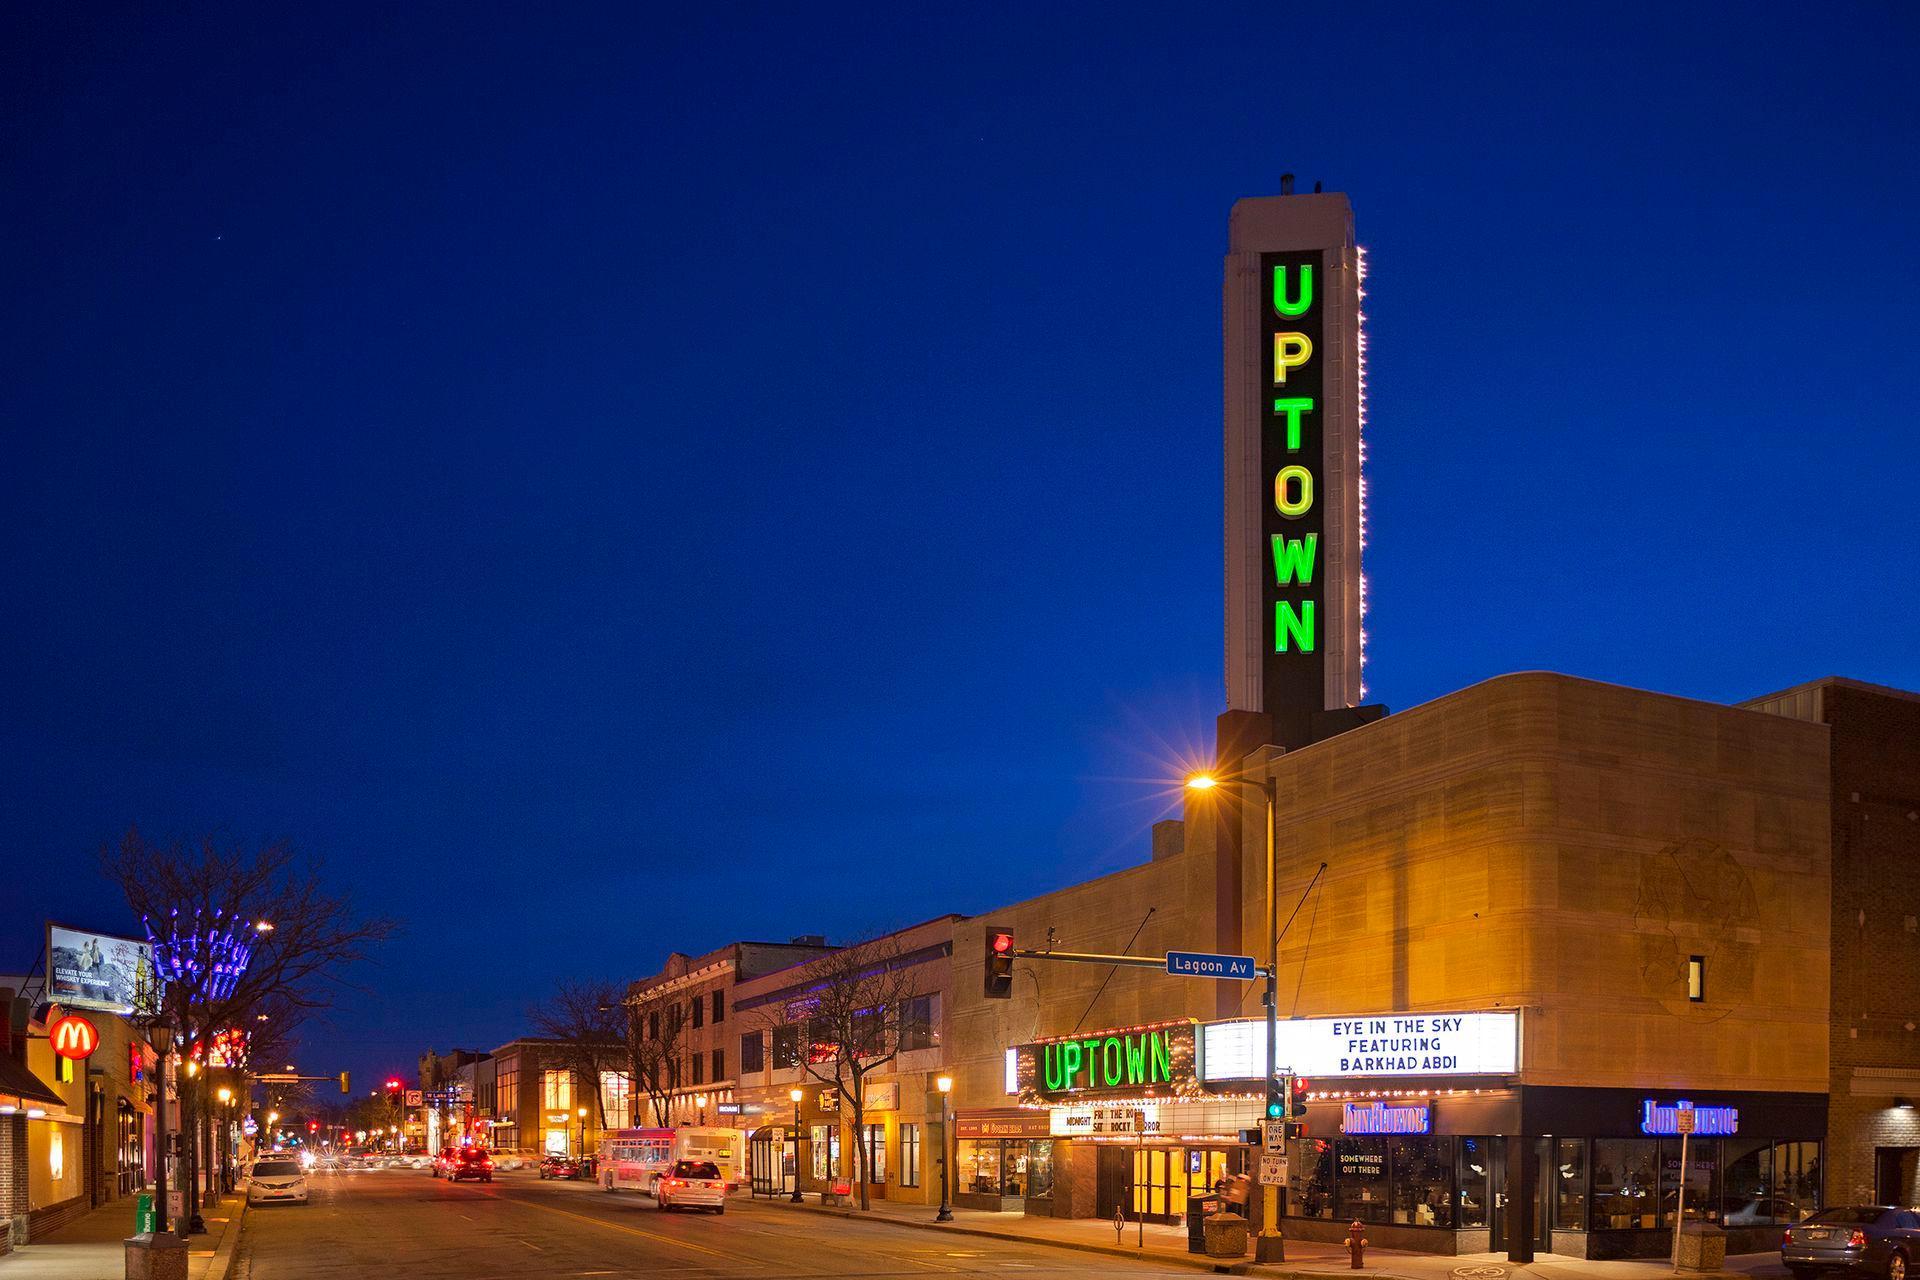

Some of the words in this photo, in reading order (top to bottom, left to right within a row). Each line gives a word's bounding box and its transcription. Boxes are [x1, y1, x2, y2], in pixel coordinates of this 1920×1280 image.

[1271, 264, 1319, 656] UPTOWN
[1175, 957, 1223, 974] Lagoon
[1230, 961, 1247, 974] Av
[55, 967, 78, 976] ELEVATE
[79, 970, 93, 979] YOUR
[55, 974, 81, 984] WHISKEY
[1333, 1021, 1363, 1036] EYE
[1369, 1020, 1386, 1034] IN
[1393, 1019, 1425, 1034] THE
[1431, 1018, 1462, 1032] SKY
[1348, 1037, 1441, 1053] FEATURING
[1045, 1030, 1170, 1090] UPTOWN
[1340, 1056, 1418, 1071] BARKHAD
[1422, 1055, 1457, 1069] ABDI
[1094, 1110, 1103, 1120] FRI
[1110, 1109, 1123, 1119] THE
[1126, 1107, 1143, 1119] RO
[1111, 1121, 1130, 1132] ROCKY
[1269, 1126, 1282, 1134] ONE
[1269, 1134, 1283, 1142] WAY
[1340, 1155, 1383, 1163] SOMEWHERE
[1342, 1166, 1357, 1174] OUT
[1358, 1166, 1380, 1174] THERE
